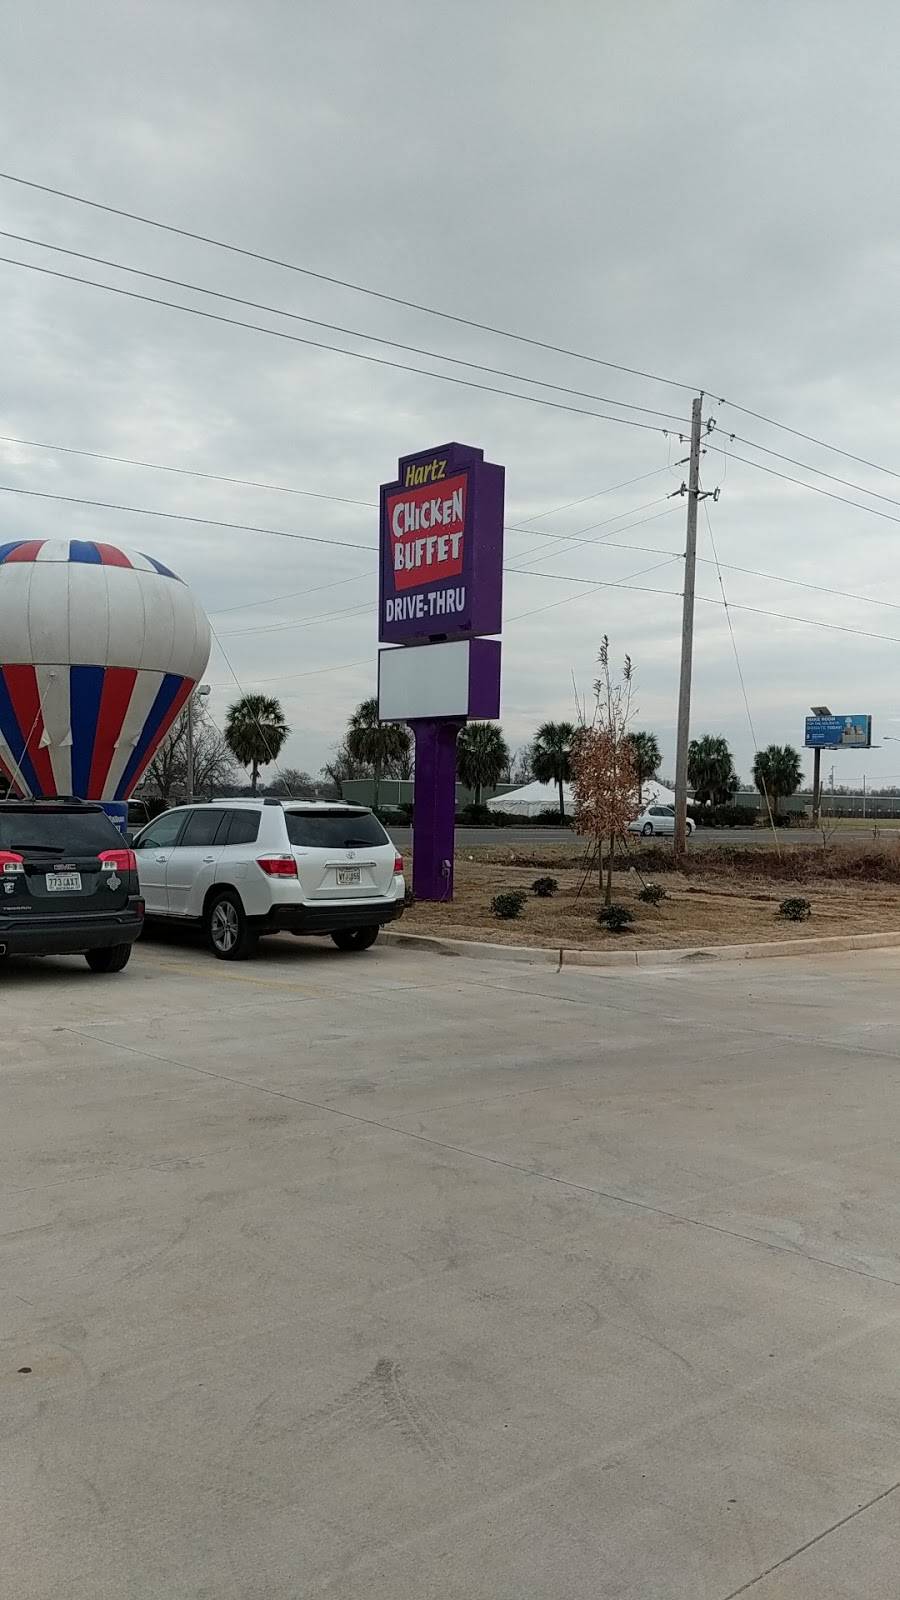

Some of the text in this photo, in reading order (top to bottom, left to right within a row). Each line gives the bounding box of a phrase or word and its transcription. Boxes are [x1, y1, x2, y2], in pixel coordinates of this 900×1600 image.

[405, 459, 447, 487] Hartz
[392, 488, 463, 537] CHICKEN
[394, 531, 463, 571] BUFFET
[386, 586, 465, 622] DRIVE-THRU
